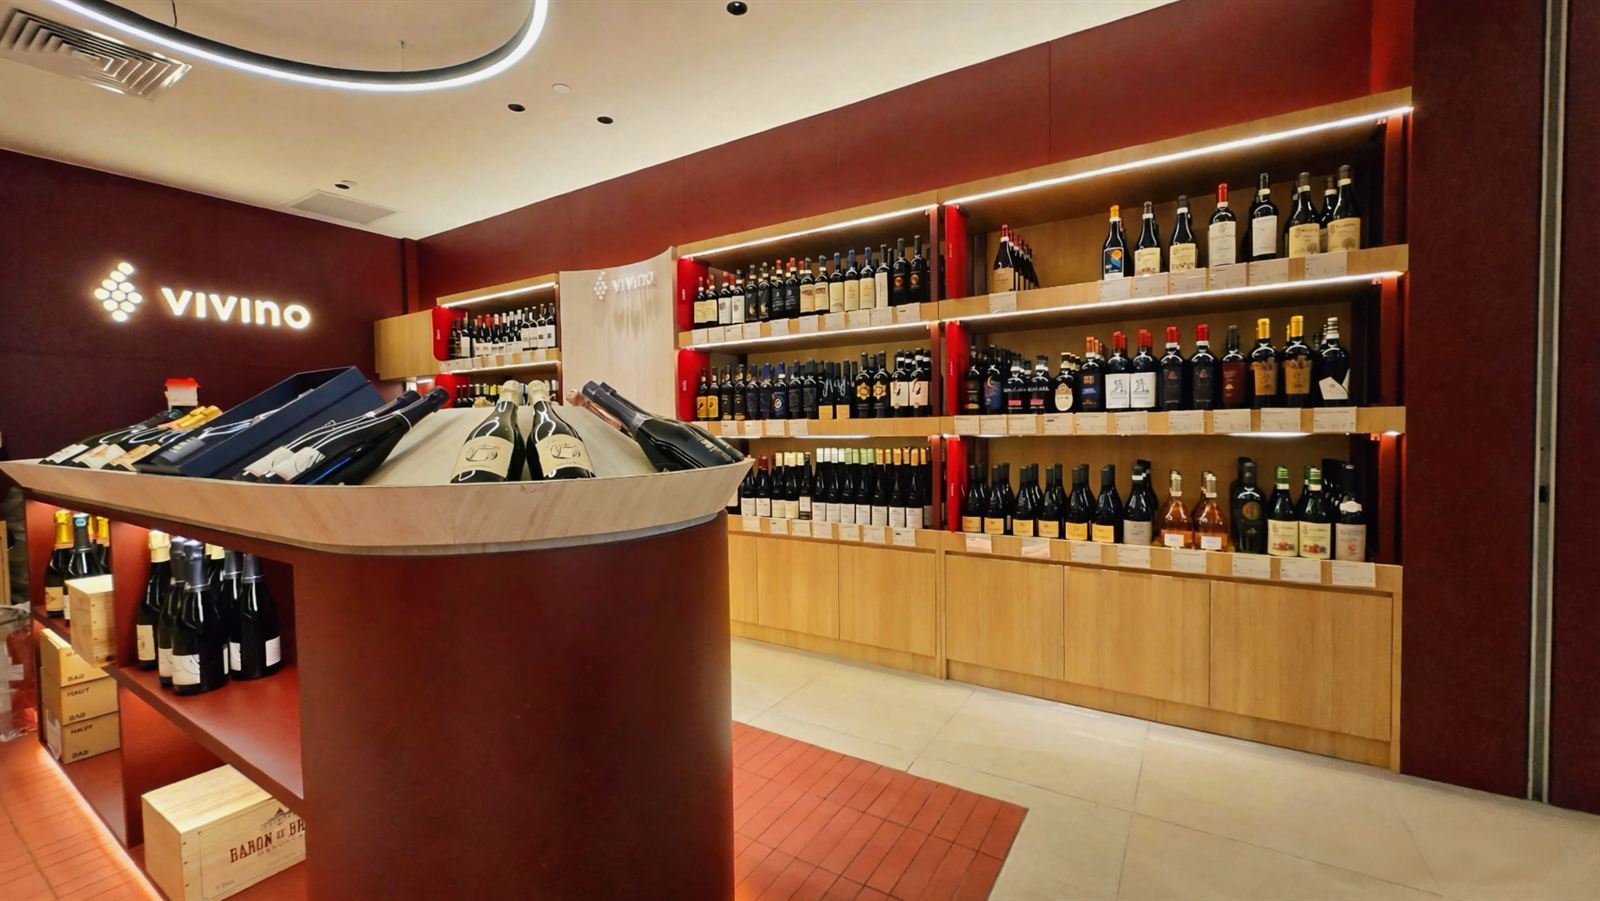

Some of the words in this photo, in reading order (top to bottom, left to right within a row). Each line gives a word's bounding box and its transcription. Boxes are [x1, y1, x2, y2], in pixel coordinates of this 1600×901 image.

[612, 271, 653, 292] vivino
[161, 287, 311, 329] vivino
[229, 832, 272, 863] BARON
